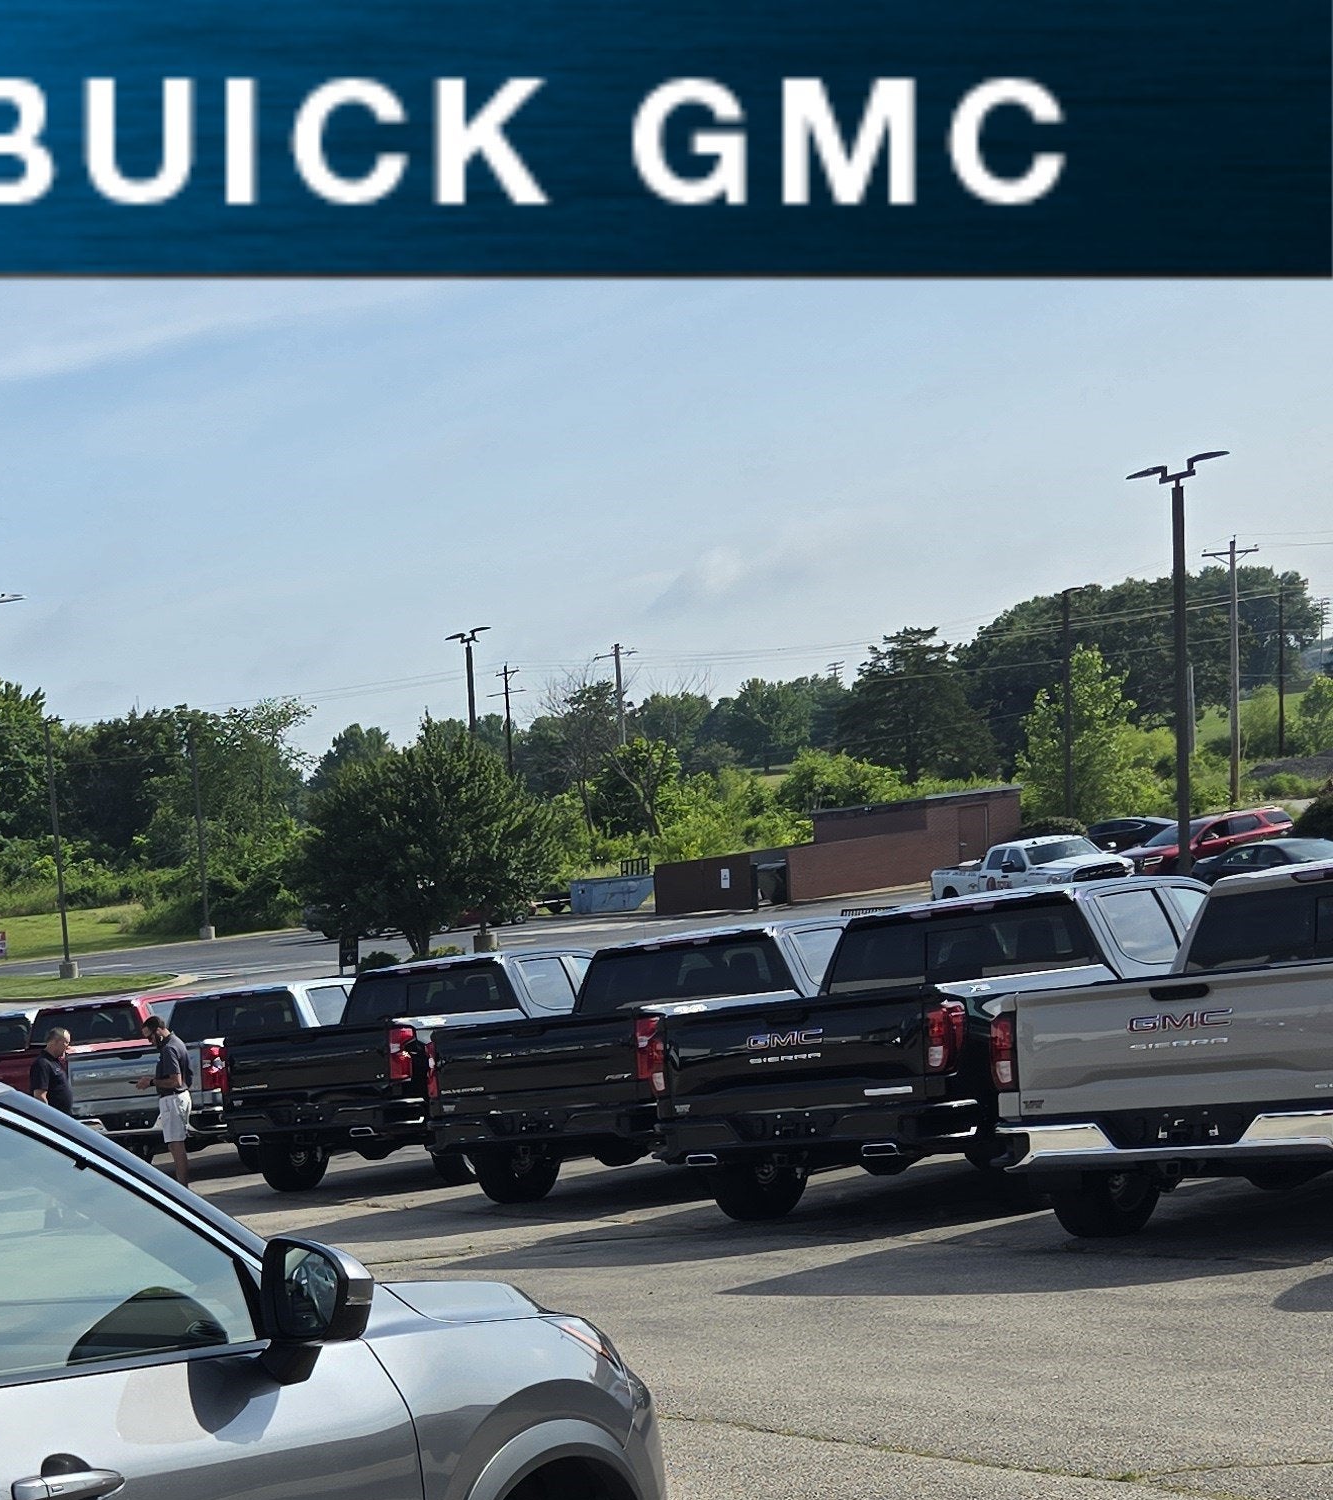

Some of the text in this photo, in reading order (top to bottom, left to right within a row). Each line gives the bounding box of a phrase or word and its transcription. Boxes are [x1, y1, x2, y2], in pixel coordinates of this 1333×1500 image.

[1126, 1007, 1233, 1035] GMC
[746, 1028, 824, 1050] GMC
[1129, 1036, 1230, 1051] SIERRA
[748, 1052, 822, 1065] SIERRA
